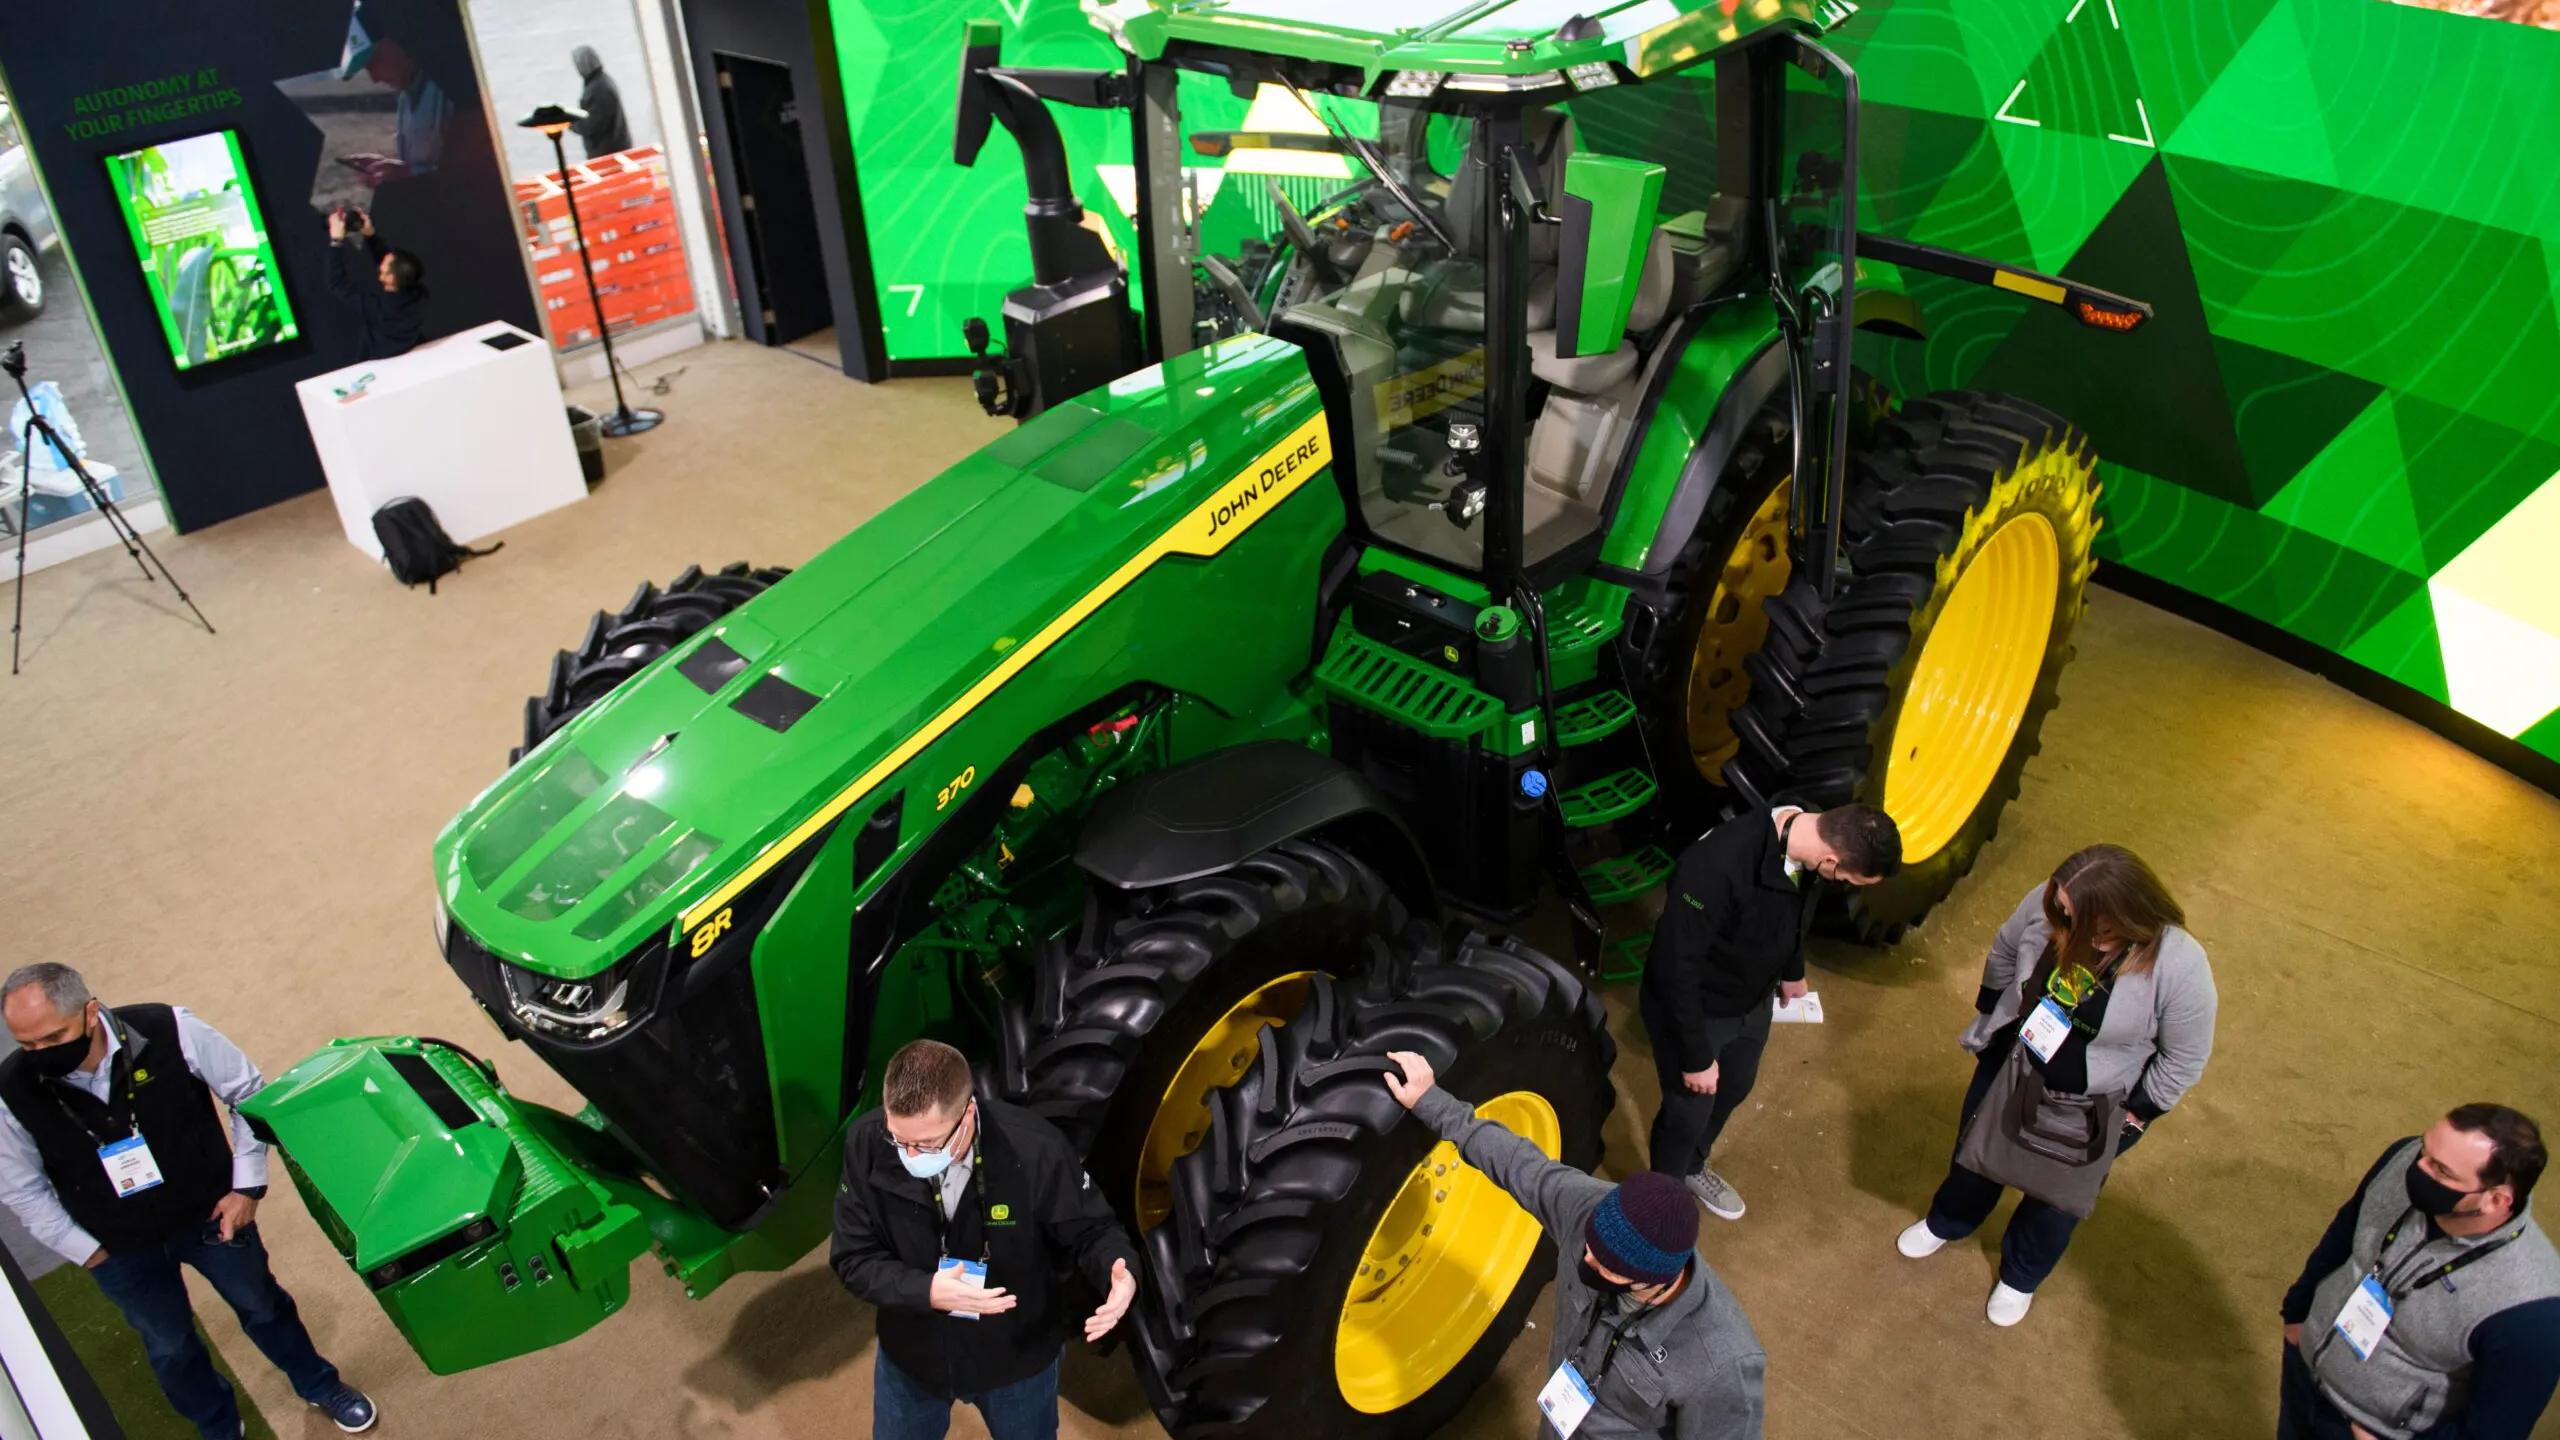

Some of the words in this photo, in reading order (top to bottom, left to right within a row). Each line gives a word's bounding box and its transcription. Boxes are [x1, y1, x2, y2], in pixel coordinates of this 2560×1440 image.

[64, 114, 124, 141] YOUR
[127, 88, 242, 127] FINGERTIPS
[73, 74, 190, 114] AUTONOMY
[197, 68, 218, 88] AT
[1207, 486, 1258, 536] JOHN
[1260, 436, 1320, 493] DEERE
[936, 765, 976, 812] 370
[690, 907, 733, 959] 8R
